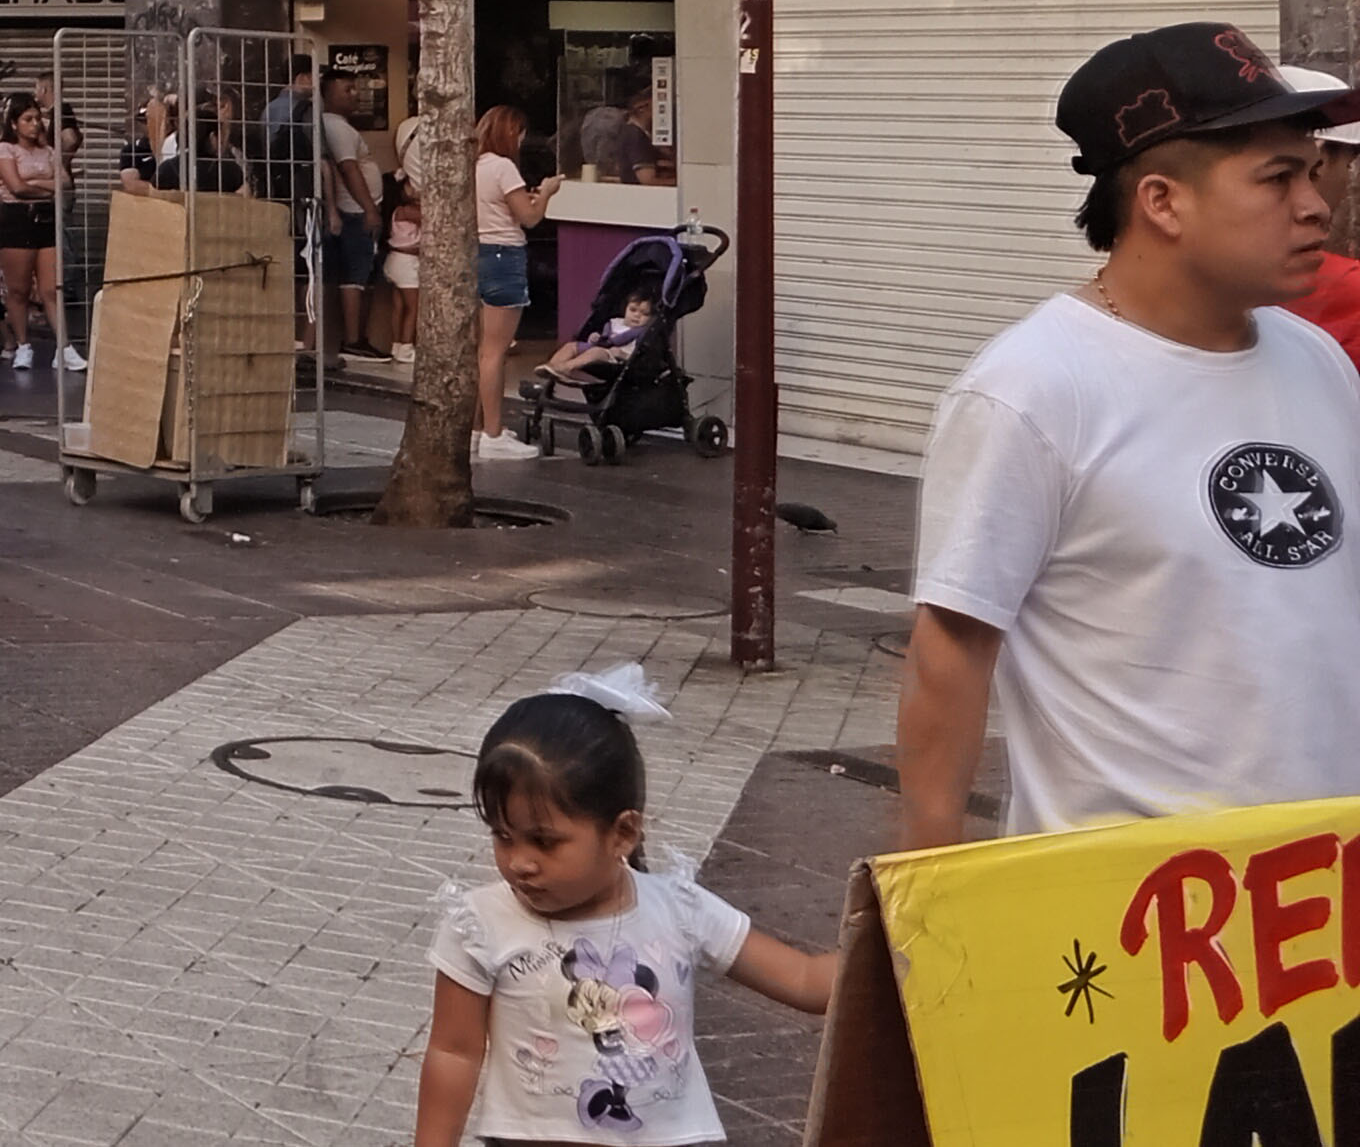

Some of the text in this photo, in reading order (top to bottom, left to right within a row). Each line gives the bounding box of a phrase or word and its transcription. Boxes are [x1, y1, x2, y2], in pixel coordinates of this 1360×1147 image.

[1219, 452, 1320, 492] CONVERSE
[1287, 530, 1333, 561] STAR
[1120, 832, 1360, 1043] RE
